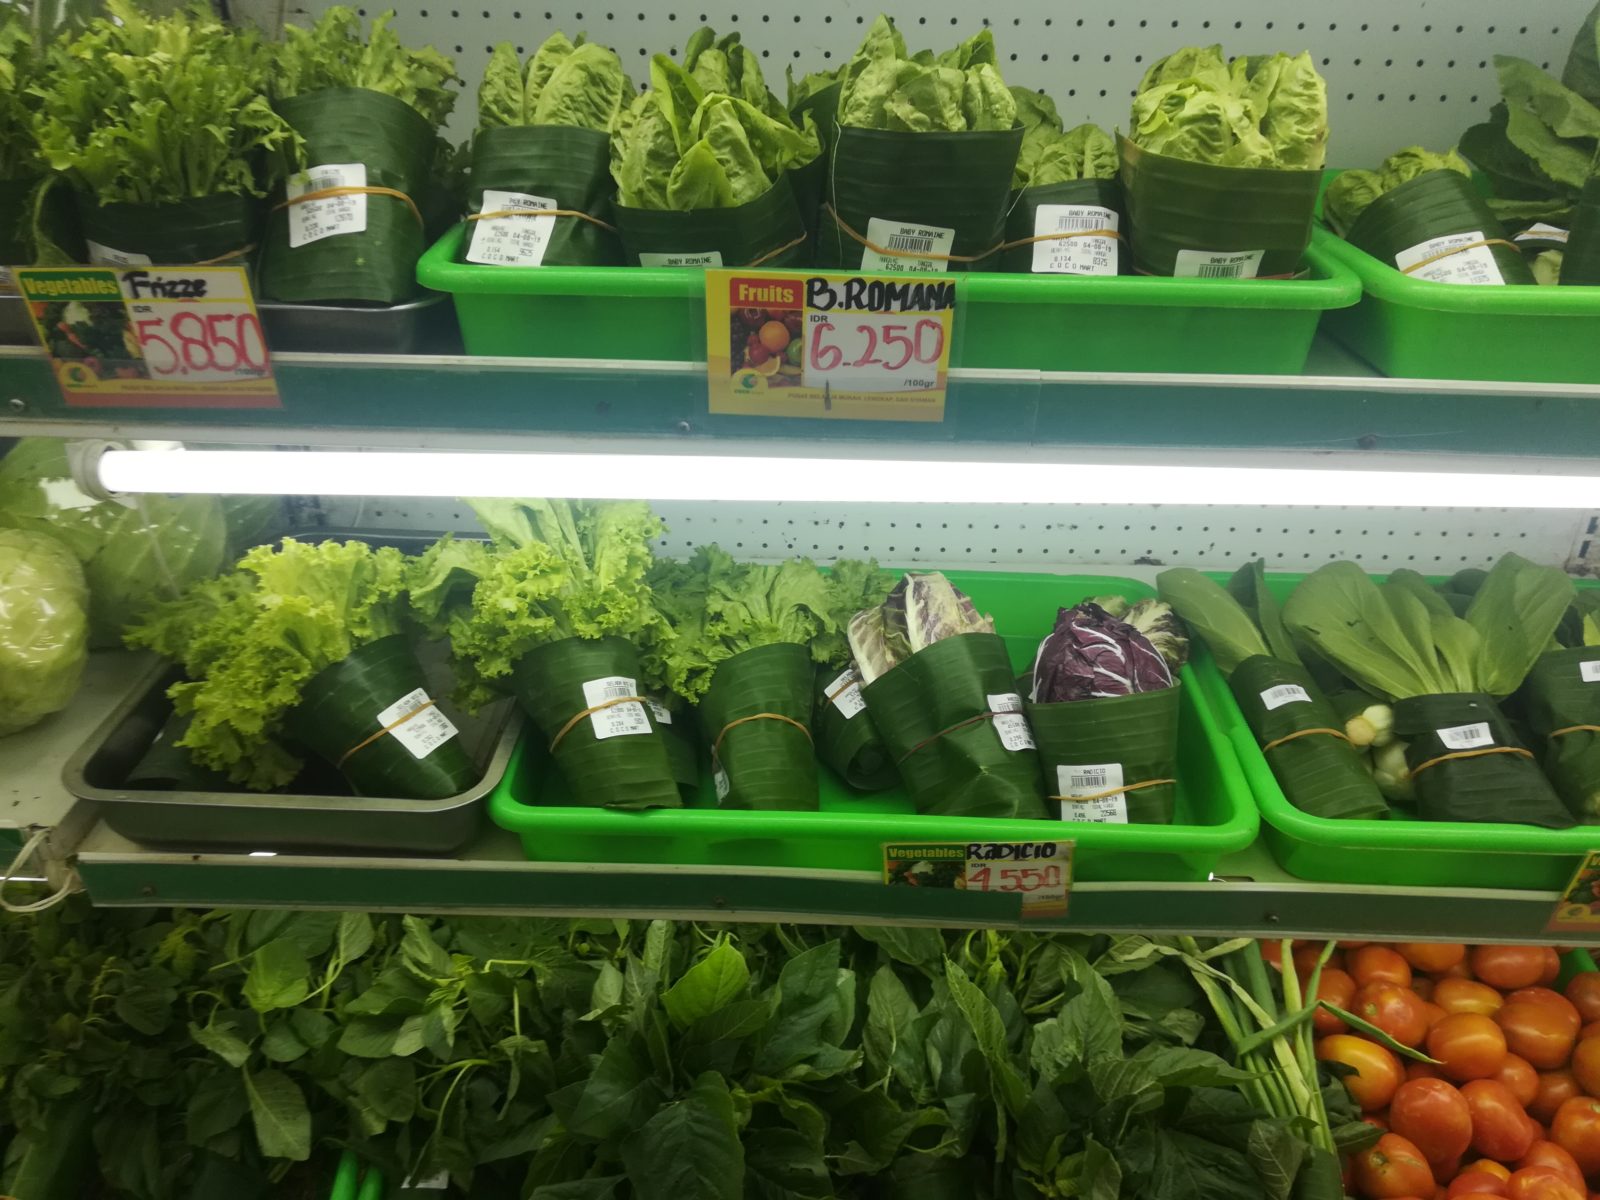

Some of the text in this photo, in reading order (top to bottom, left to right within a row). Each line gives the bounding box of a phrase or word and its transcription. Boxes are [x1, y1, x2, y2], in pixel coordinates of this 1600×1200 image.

[899, 227, 945, 239] BABY ROMAINE
[667, 256, 712, 265] BABY ROMAINE
[23, 277, 118, 295] Vegetables
[121, 271, 207, 299] Frizze
[739, 284, 794, 304] Fruits
[132, 305, 153, 313] IDR
[810, 315, 828, 323] IDR
[903, 379, 935, 389] /100gr
[888, 847, 964, 859] Vegetables
